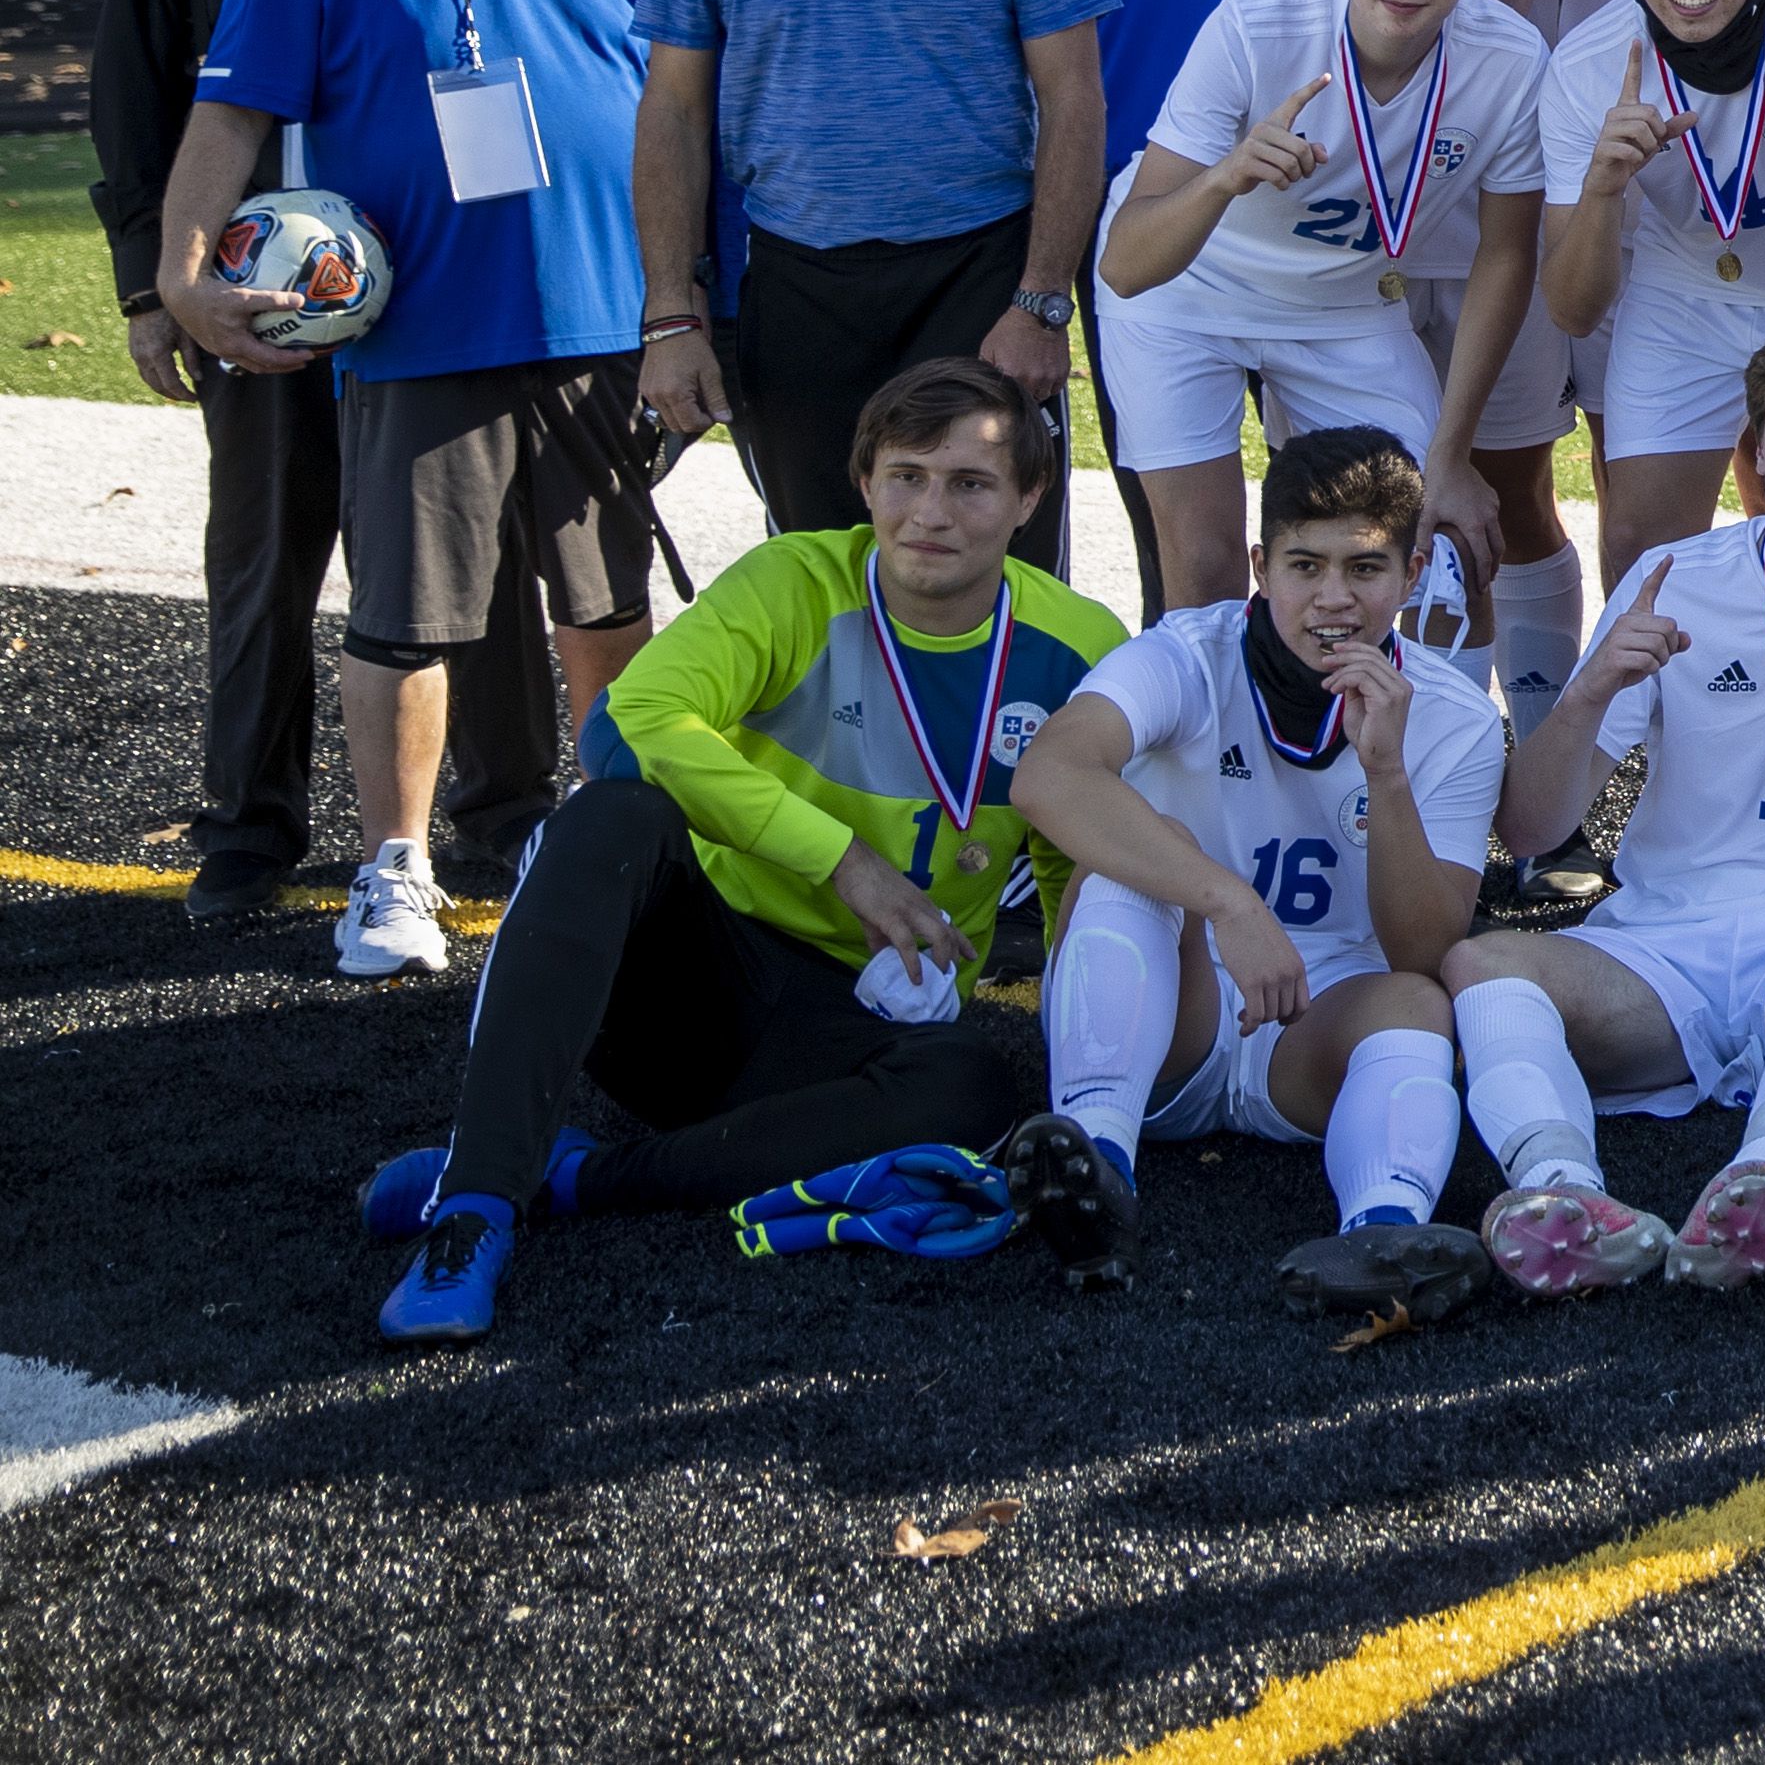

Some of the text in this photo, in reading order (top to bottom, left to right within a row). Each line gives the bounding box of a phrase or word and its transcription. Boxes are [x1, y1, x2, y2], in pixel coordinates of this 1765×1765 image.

[1707, 680, 1757, 693] adidas
[904, 802, 941, 891] 1
[1252, 838, 1338, 926] 16
